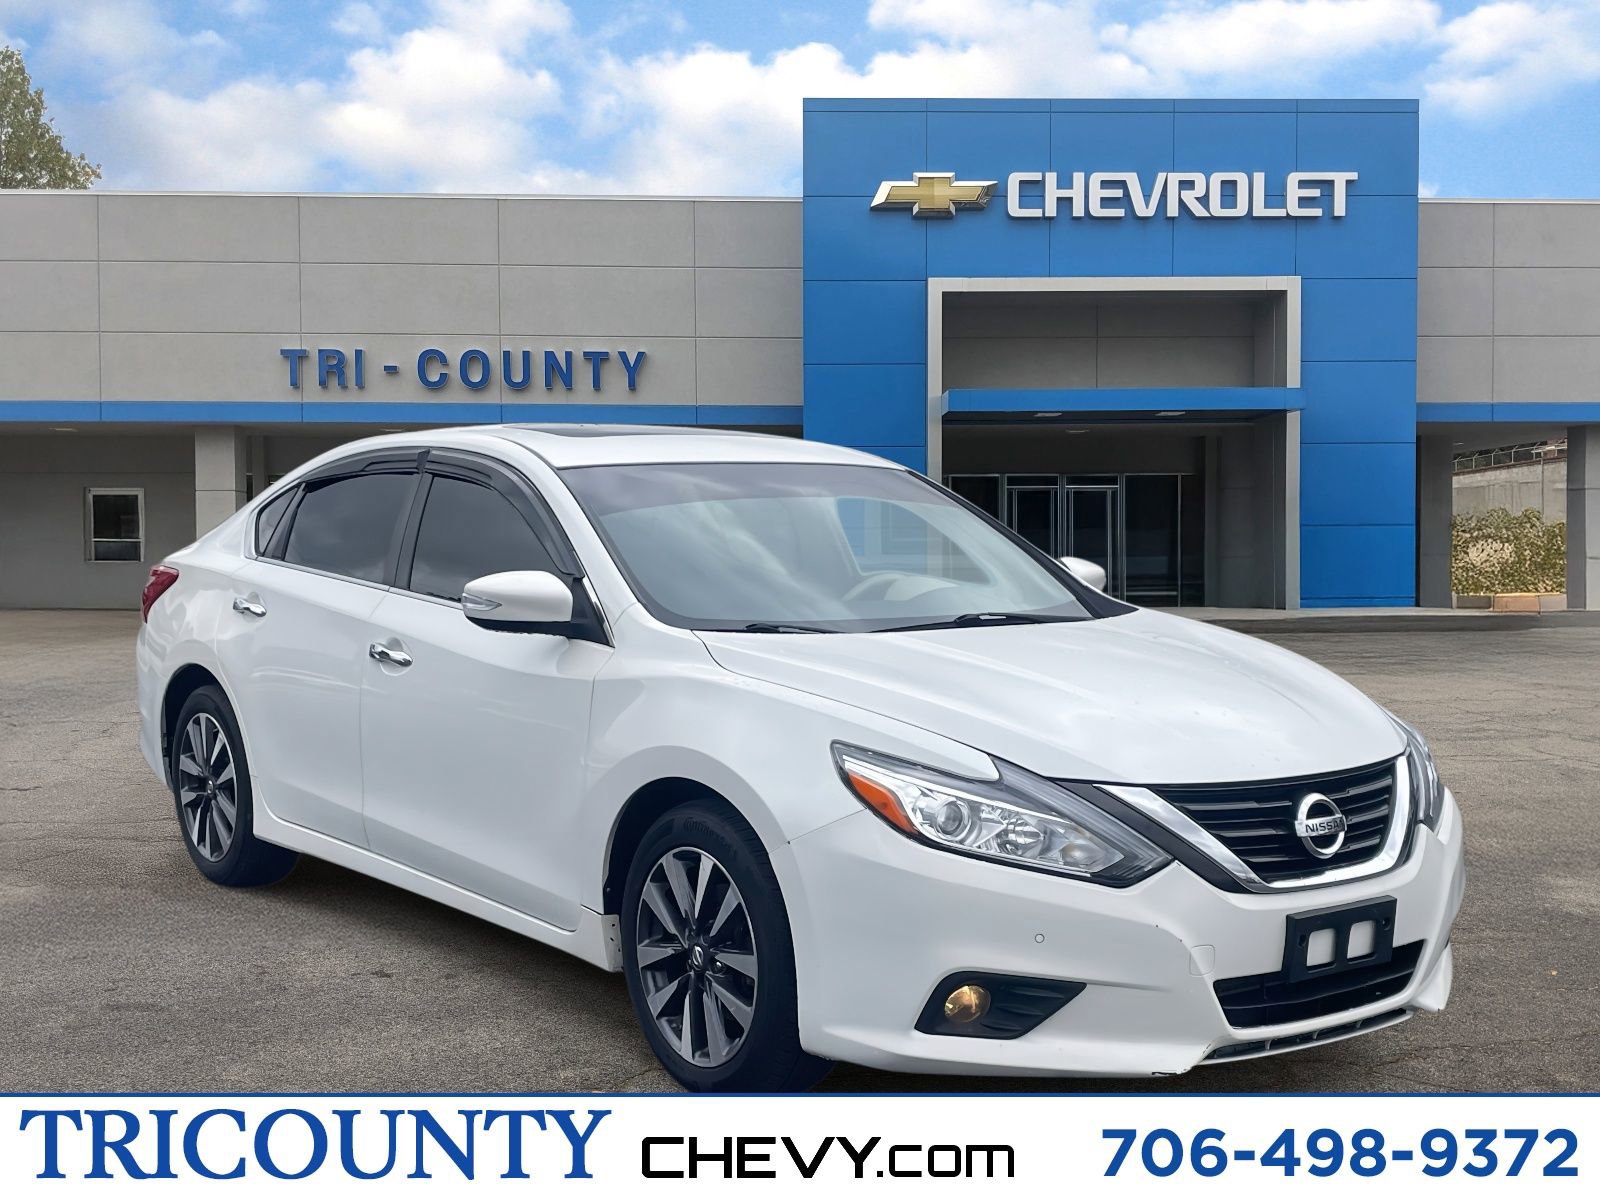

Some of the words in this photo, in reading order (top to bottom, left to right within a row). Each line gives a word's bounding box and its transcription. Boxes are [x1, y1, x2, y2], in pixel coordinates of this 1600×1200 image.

[1006, 171, 1359, 218] CHEVROLET
[280, 348, 366, 389] TRI
[416, 347, 647, 391] COUNTY
